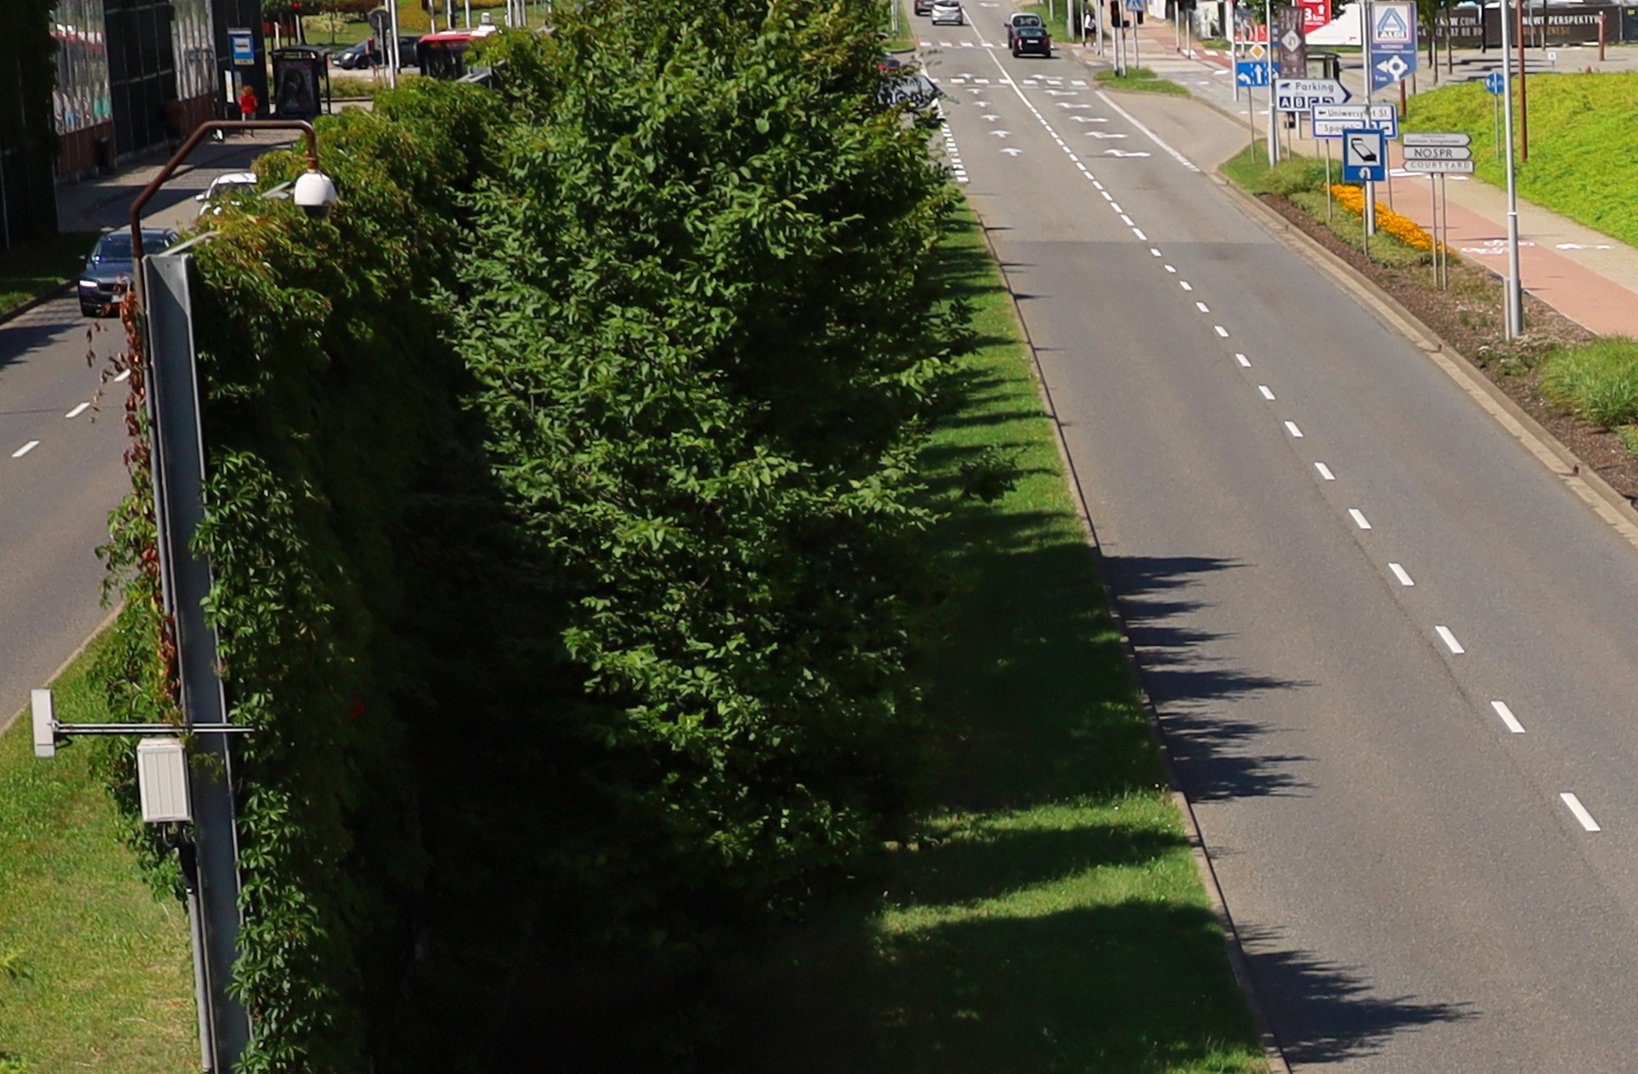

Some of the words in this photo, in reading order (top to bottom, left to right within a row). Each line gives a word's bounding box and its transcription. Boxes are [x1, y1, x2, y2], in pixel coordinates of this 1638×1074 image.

[1548, 15, 1601, 25] PERSPEKTYW
[1295, 83, 1335, 92] Parking
[1281, 98, 1291, 107] A
[1414, 148, 1453, 158] NOSPR
[1410, 161, 1470, 169] COURTYARD
